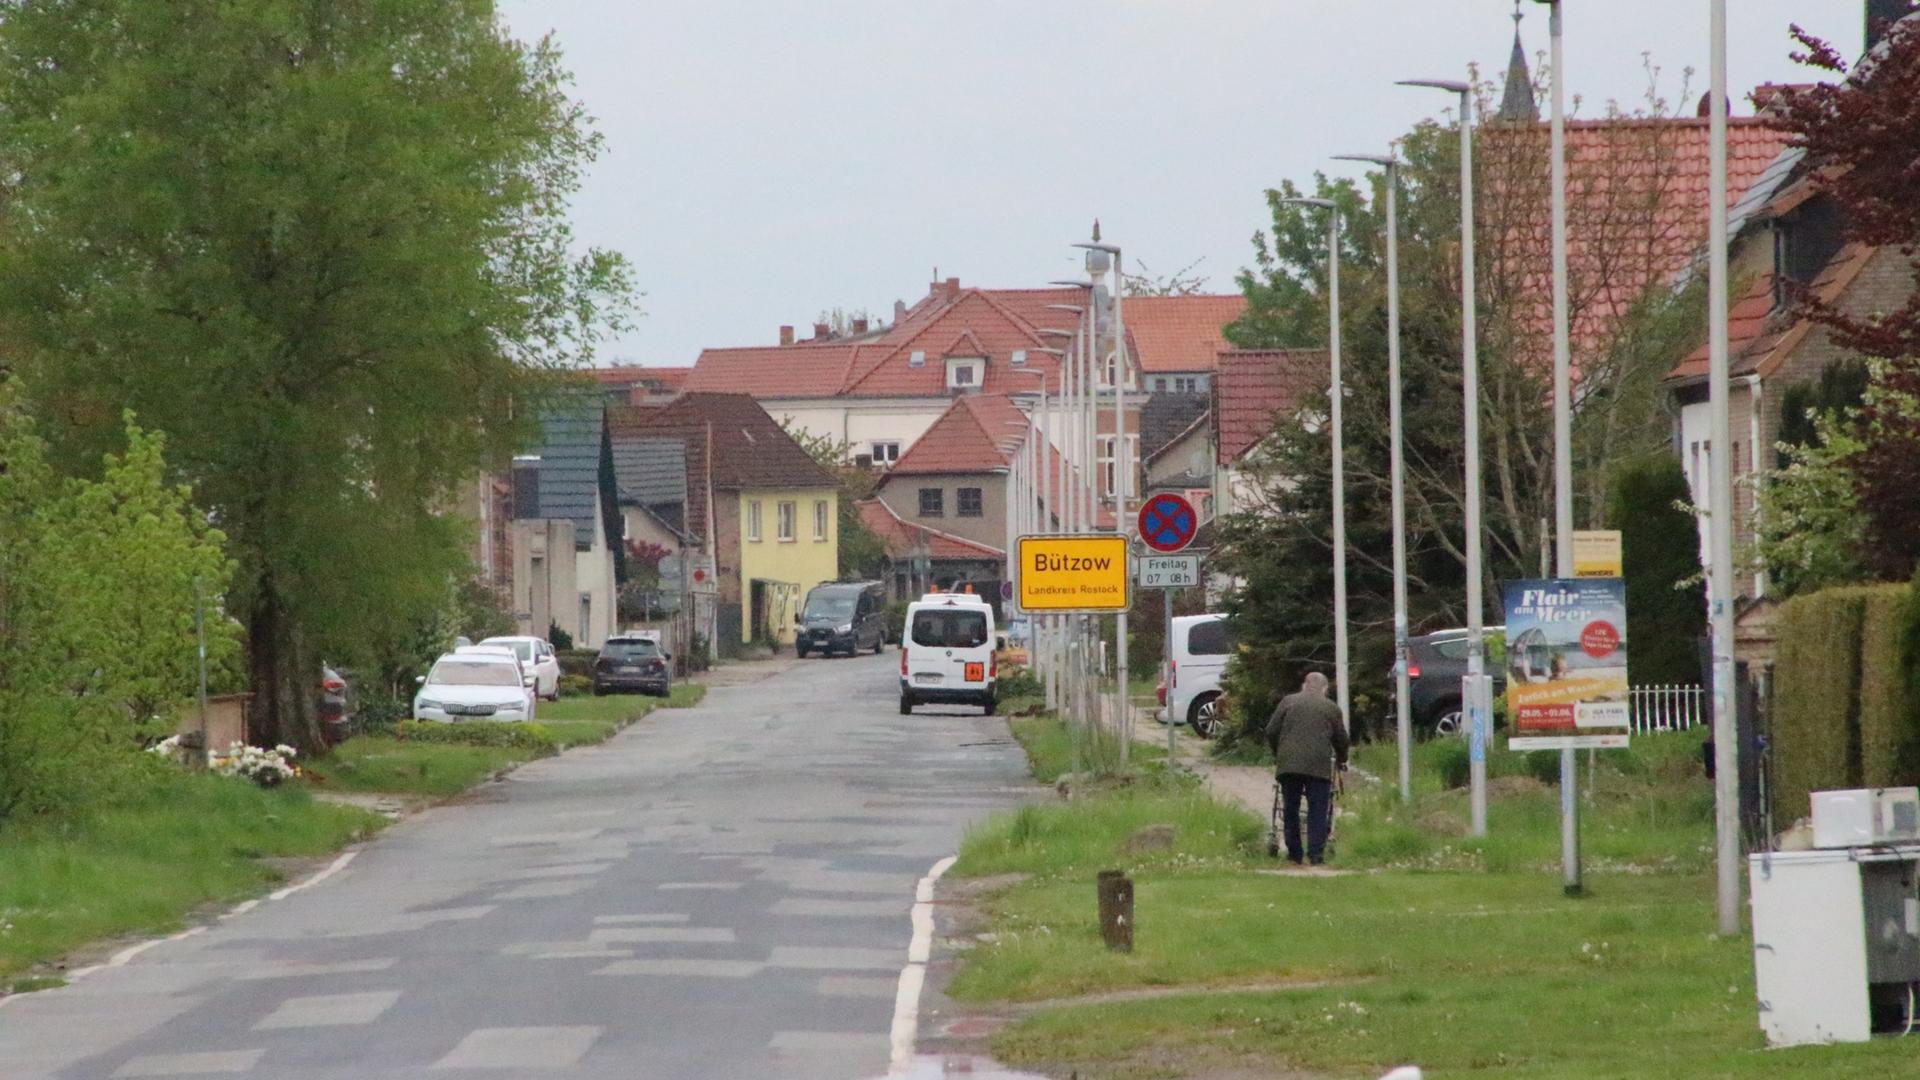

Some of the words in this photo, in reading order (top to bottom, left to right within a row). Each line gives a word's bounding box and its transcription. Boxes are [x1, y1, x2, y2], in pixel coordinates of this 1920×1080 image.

[1035, 553, 1110, 571] Bützow
[1149, 559, 1188, 570] Freitag
[1147, 573, 1161, 584] 07
[1028, 585, 1076, 595] Landkreis
[1080, 584, 1118, 594] Rostock
[1521, 589, 1580, 606] Flair
[1514, 606, 1534, 614] am
[1536, 606, 1592, 622] Meer
